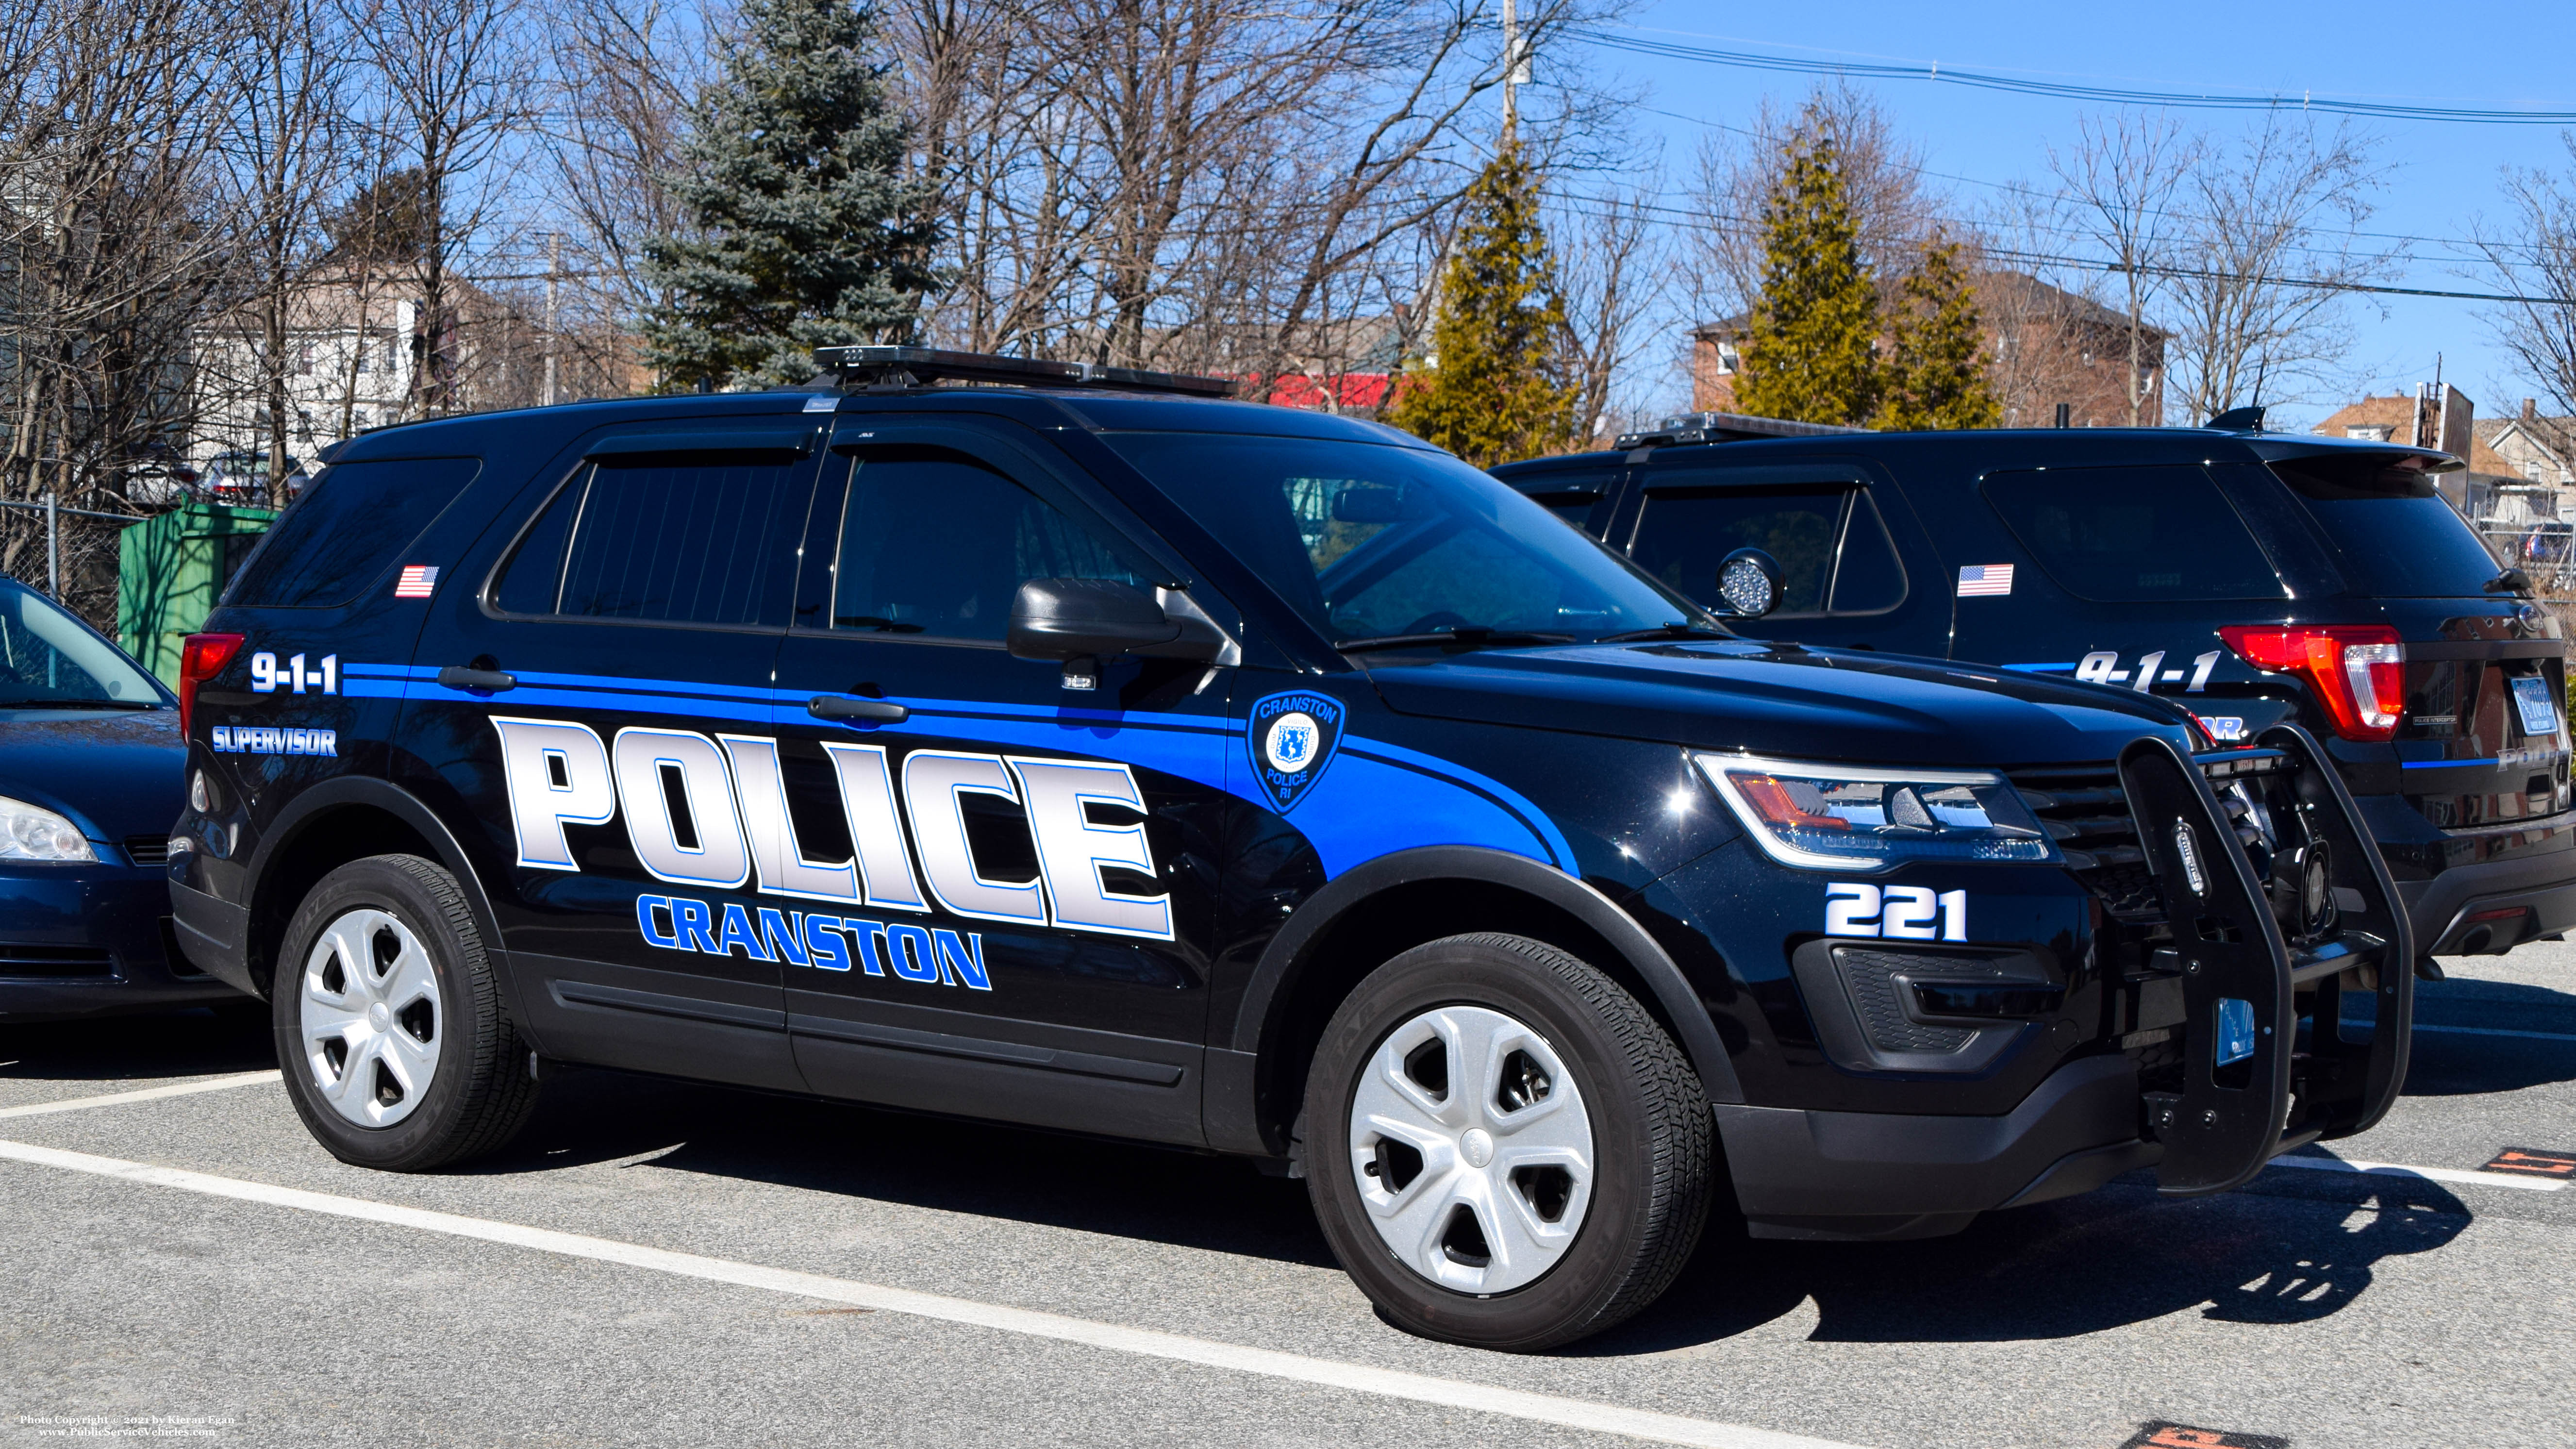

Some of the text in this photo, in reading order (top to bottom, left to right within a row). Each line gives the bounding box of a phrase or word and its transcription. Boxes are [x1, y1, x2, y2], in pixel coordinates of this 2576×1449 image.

[251, 652, 337, 695] 9-1-1
[2076, 650, 2220, 693] 9-1-1
[1260, 697, 1336, 723] CRANSTON
[212, 726, 338, 757] SUPERVISOR
[1267, 768, 1307, 786] POLICE
[1280, 787, 1291, 799] RI
[489, 716, 1176, 941] POLICE
[1825, 882, 1968, 942] 221
[637, 894, 992, 991] CRANSTON
